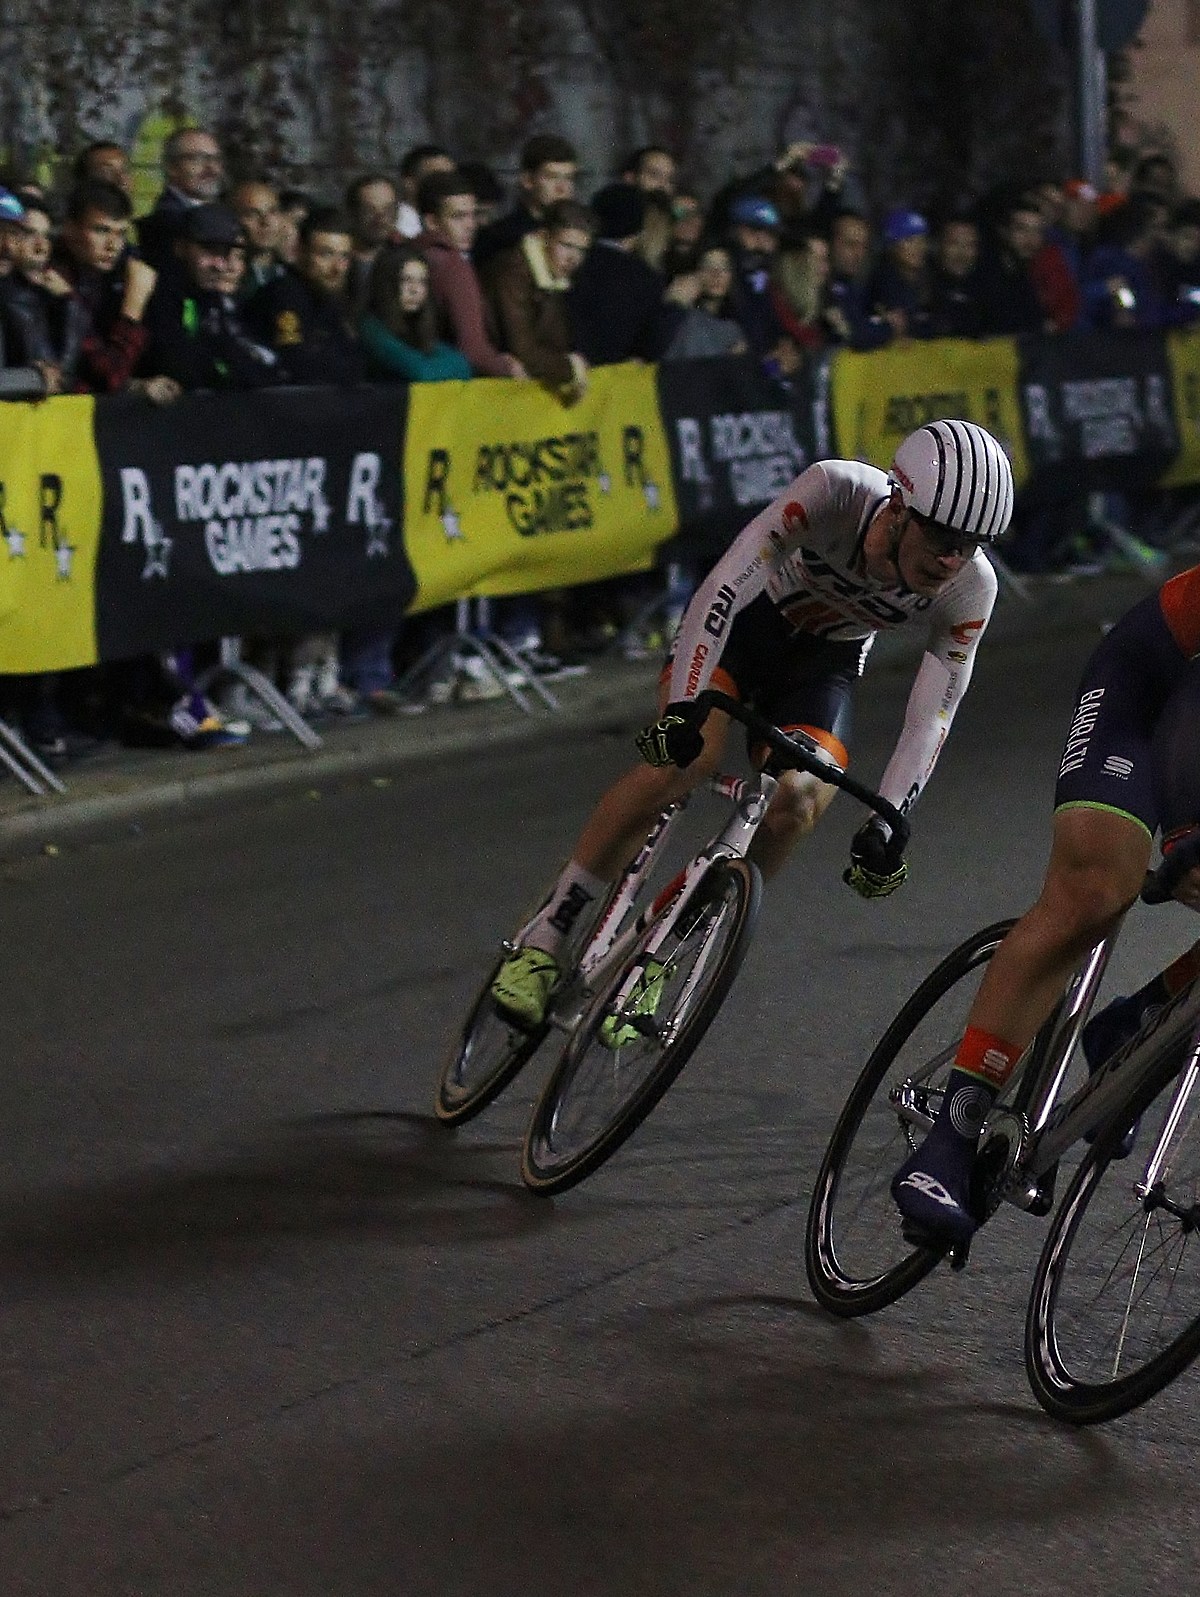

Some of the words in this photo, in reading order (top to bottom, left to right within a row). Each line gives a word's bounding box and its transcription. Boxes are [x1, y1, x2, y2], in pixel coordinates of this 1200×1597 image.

[174, 457, 331, 531] ROCKSTAR
[347, 452, 386, 533] R
[424, 449, 449, 518] R
[624, 425, 647, 490] R
[39, 473, 63, 551] R
[120, 467, 168, 552] R
[205, 515, 301, 575] GAMES
[1059, 688, 1105, 779] BAHRAIN
